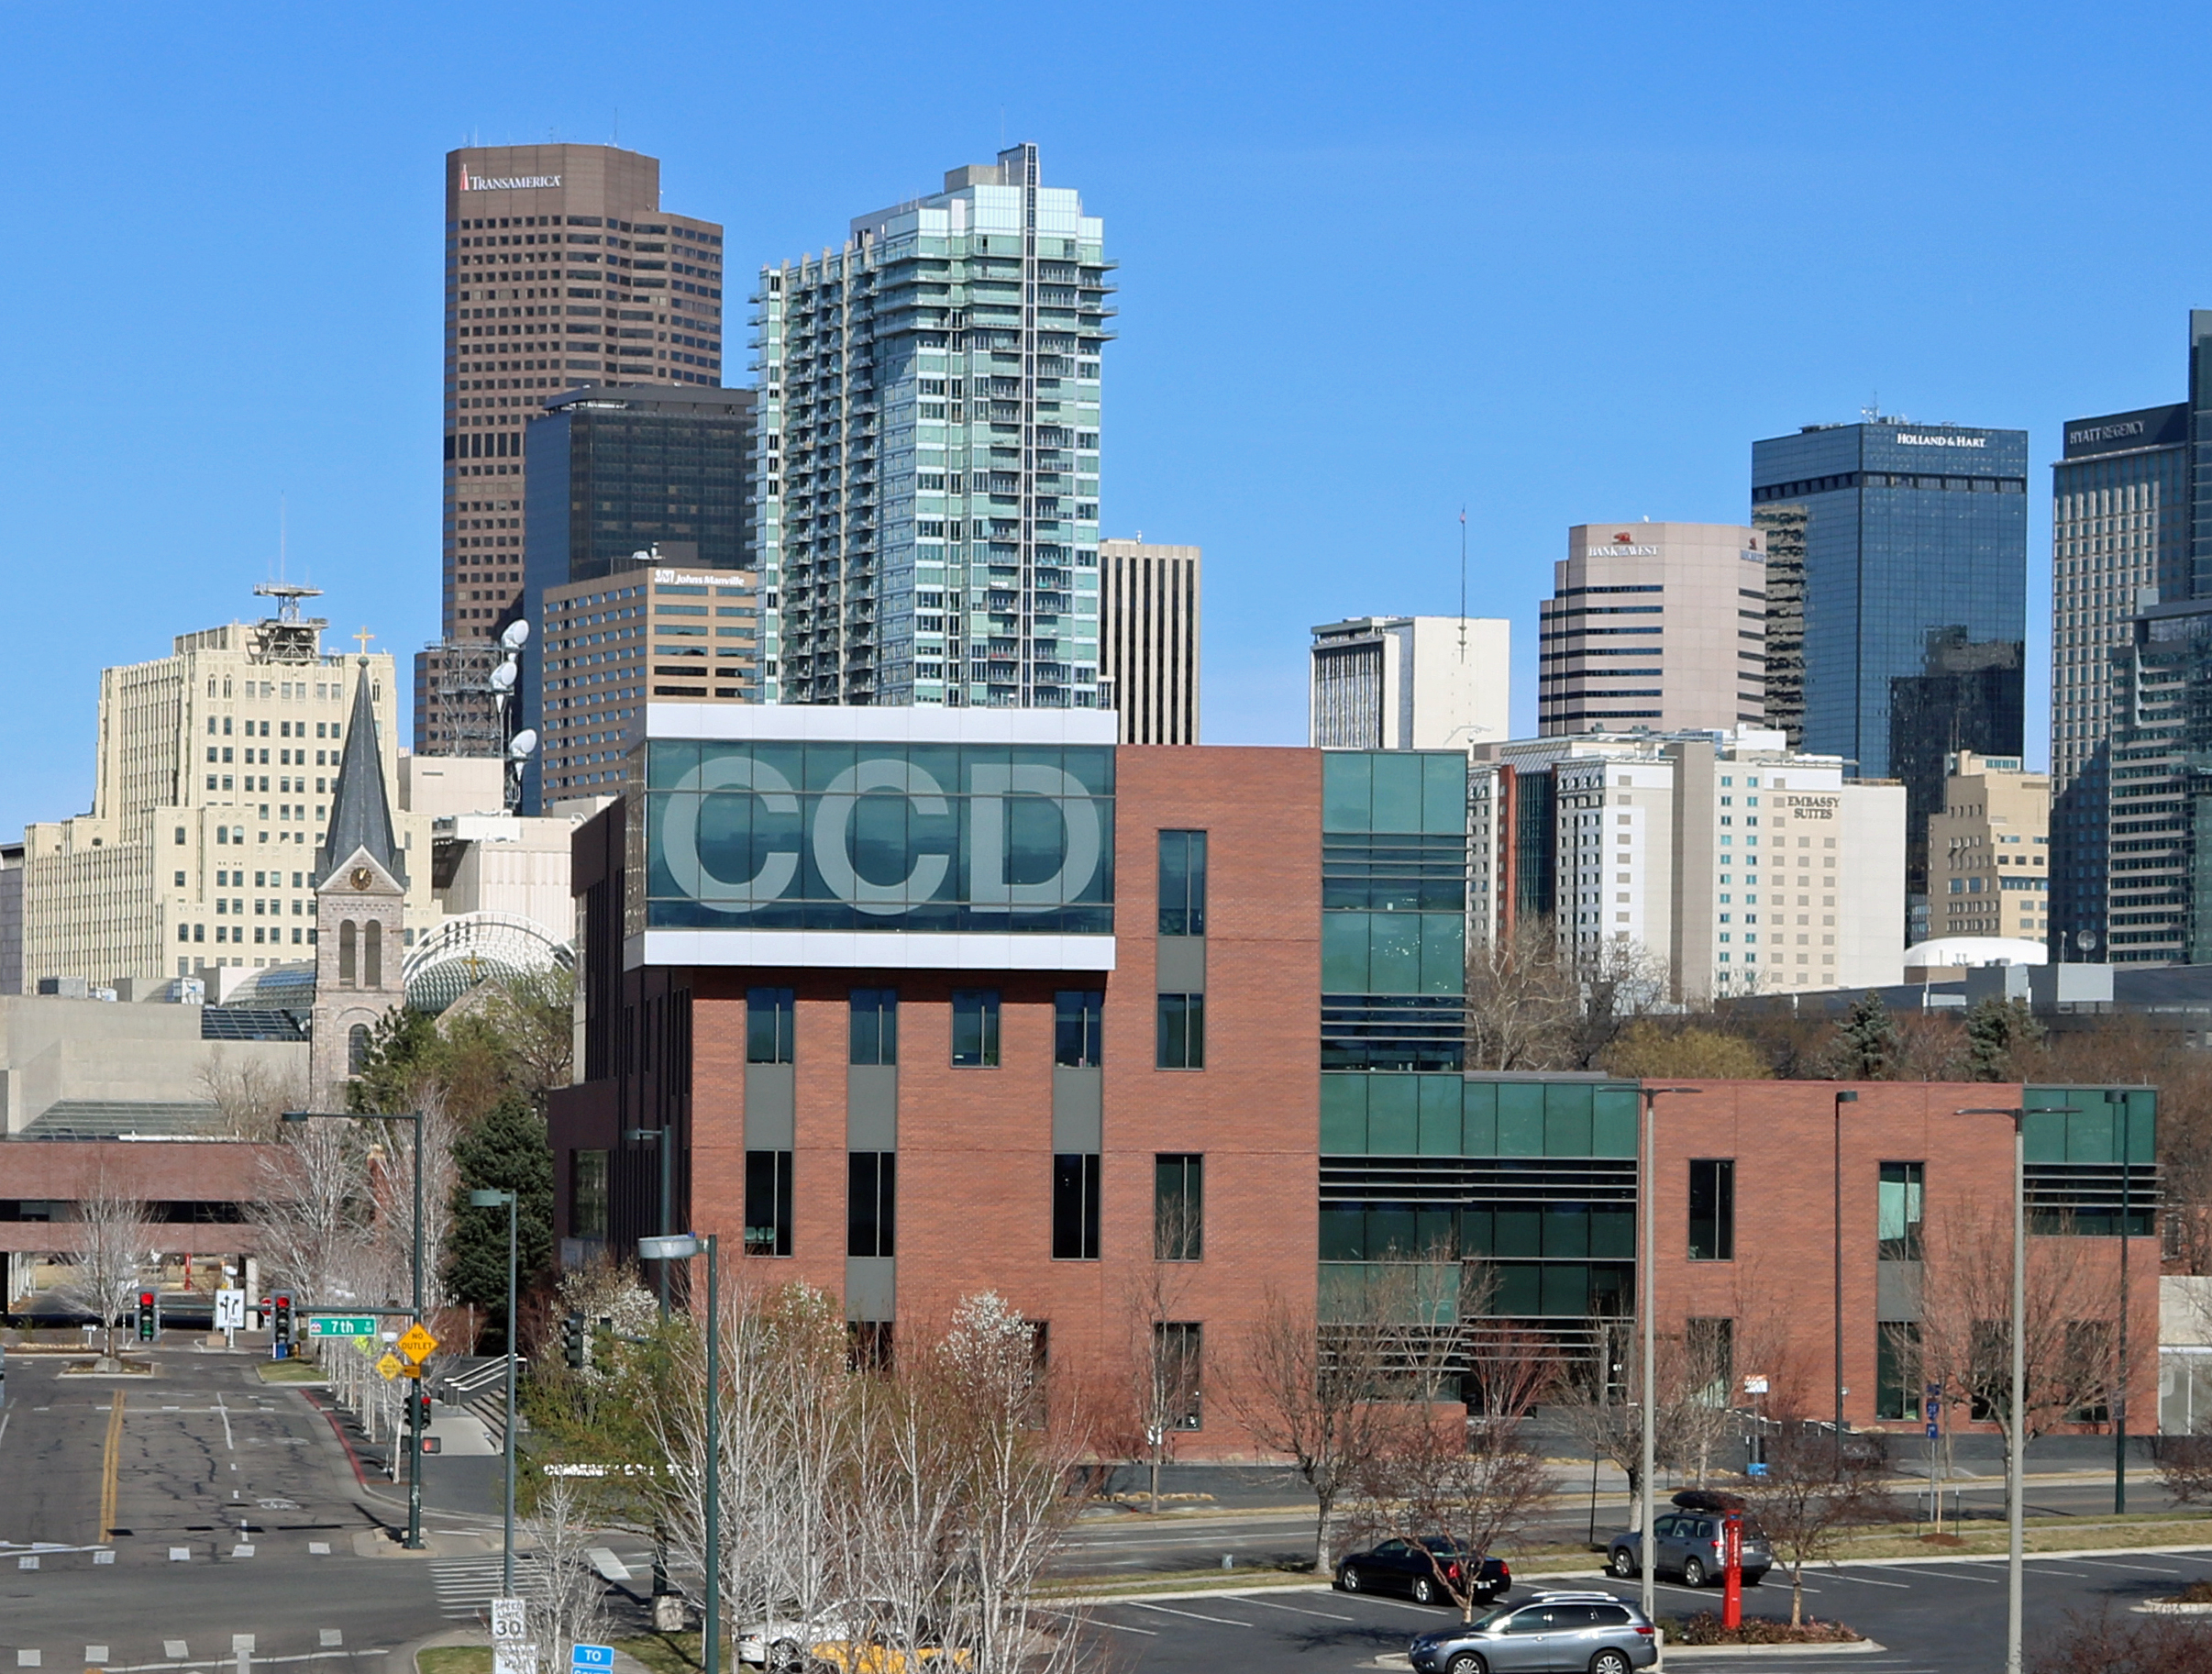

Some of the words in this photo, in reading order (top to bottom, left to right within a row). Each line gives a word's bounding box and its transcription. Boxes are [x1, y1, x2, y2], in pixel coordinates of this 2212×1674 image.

[470, 174, 561, 192] TRANSAMERICA
[2070, 427, 2102, 445] HYATT
[2102, 421, 2145, 440] REGENCY
[1897, 433, 1946, 447] HOLLAND
[1947, 437, 1955, 447] &
[1956, 436, 1986, 449] HART
[1588, 545, 1619, 557] BANK
[1627, 545, 1658, 557] WEST
[675, 573, 703, 585] Johns
[703, 574, 745, 586] Manville
[1787, 795, 1841, 808] EMBASSY
[1794, 808, 1833, 820] SUITES
[662, 756, 1100, 915] CCD
[330, 1321, 355, 1334] 7th
[402, 1342, 433, 1350] OUTLET
[496, 1620, 522, 1635] 30
[584, 1649, 602, 1662] TO
